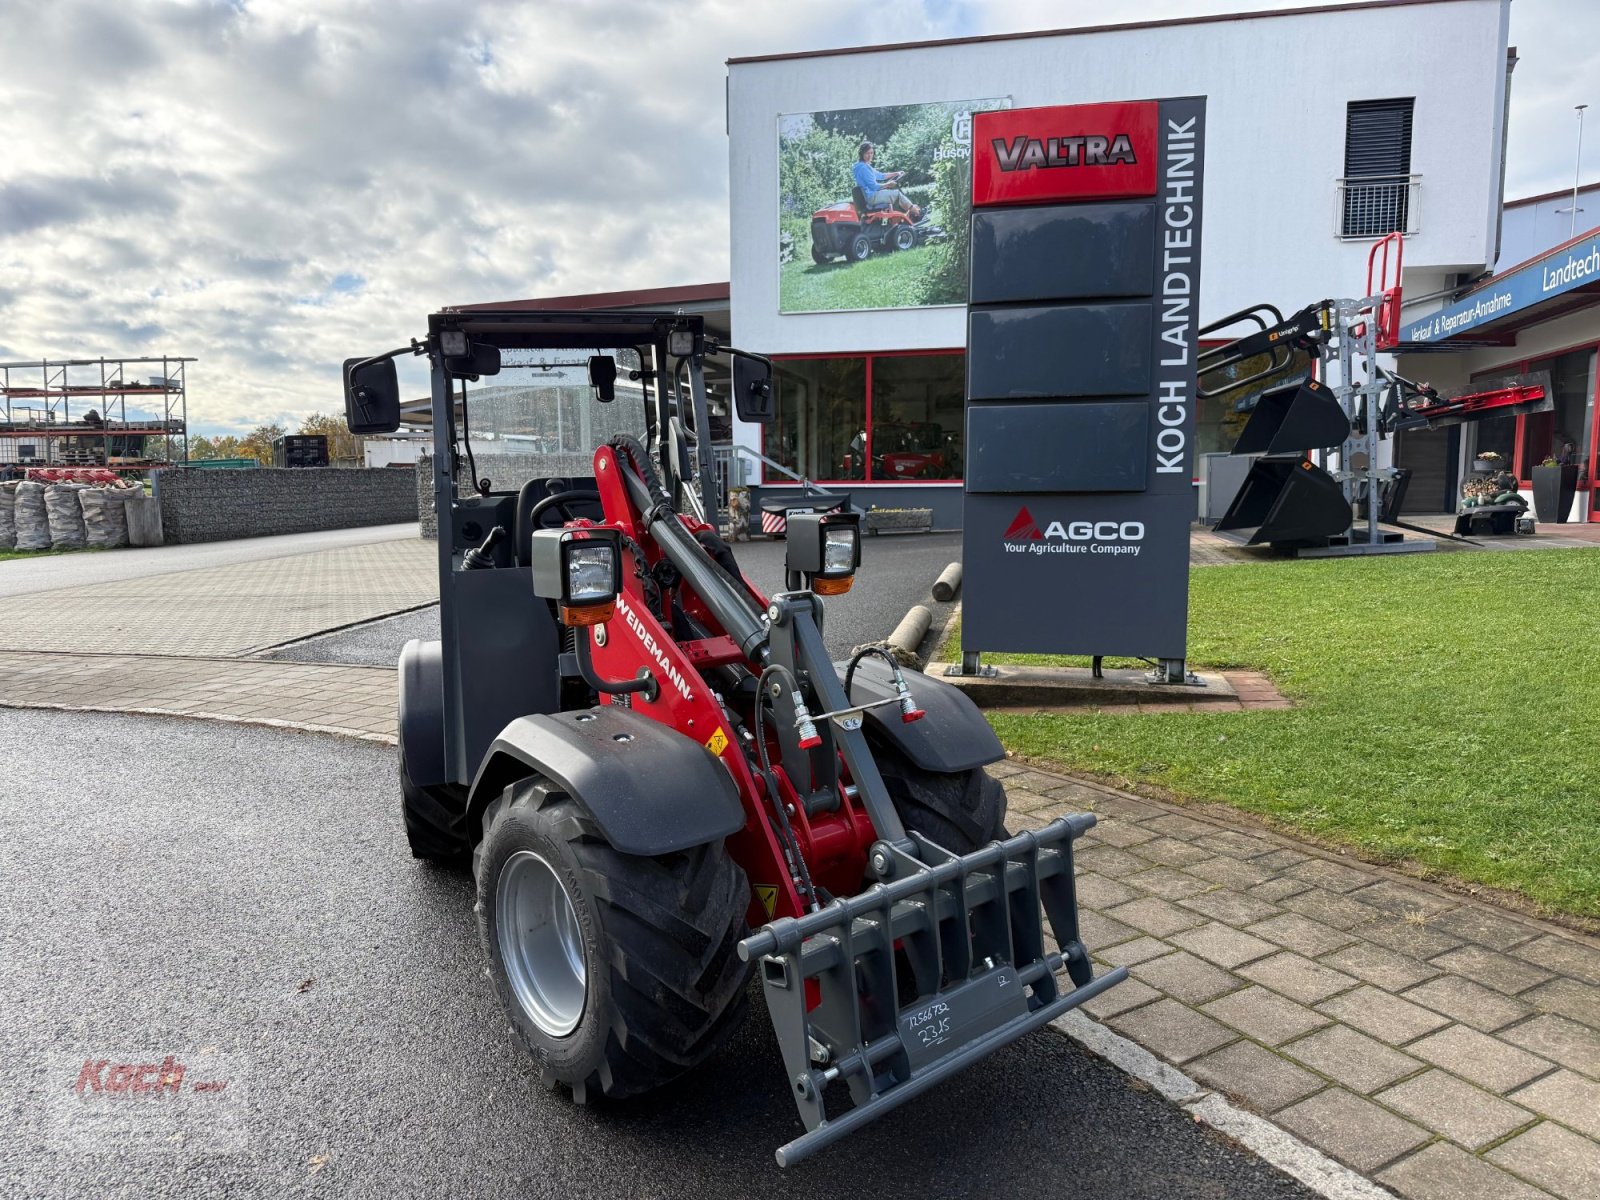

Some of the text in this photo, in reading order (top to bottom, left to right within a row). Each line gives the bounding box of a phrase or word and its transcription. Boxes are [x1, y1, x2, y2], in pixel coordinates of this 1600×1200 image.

[933, 148, 971, 161] Husqv
[992, 133, 1138, 172] VALTRA
[1543, 245, 1600, 292] Landtech
[1155, 116, 1196, 474] KOCH LANDTECHNIK
[1278, 325, 1299, 337] Unigrip
[1411, 292, 1512, 342] Verkauf & Reparatur-Annahme
[1003, 542, 1141, 556] Your Agriculture Company
[1044, 521, 1145, 541] AGCO
[616, 592, 691, 700] WEIDEMANN
